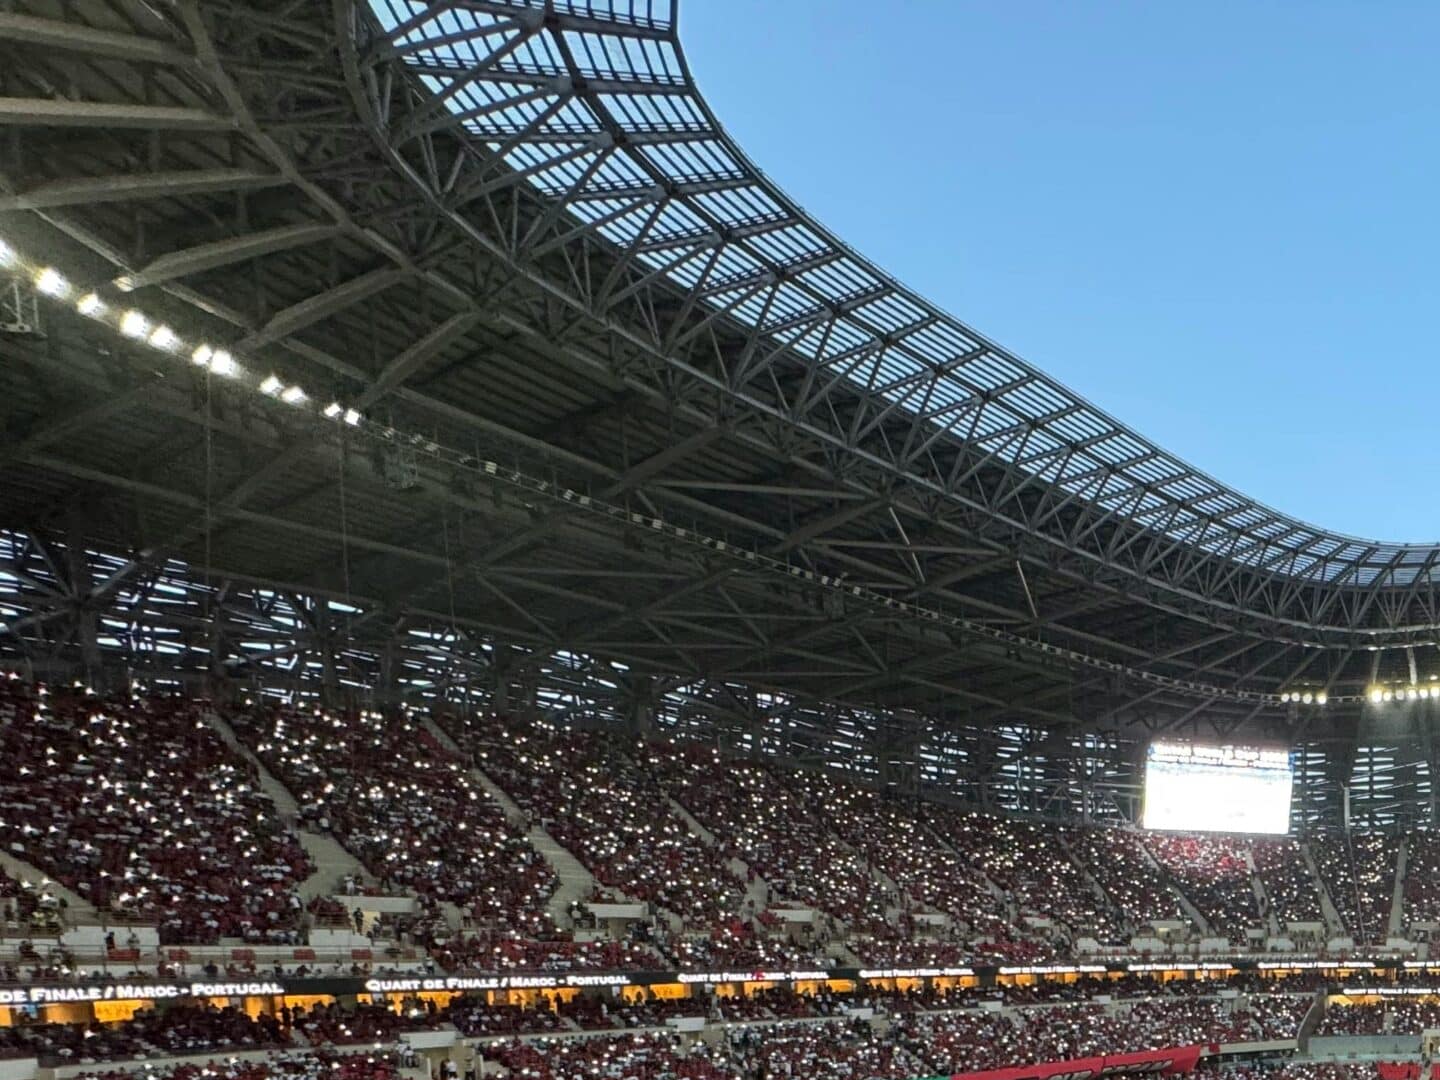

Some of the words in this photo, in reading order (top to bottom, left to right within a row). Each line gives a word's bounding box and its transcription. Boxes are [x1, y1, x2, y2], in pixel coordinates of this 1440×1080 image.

[366, 979, 421, 991] QUART
[423, 979, 444, 989] DE
[446, 978, 499, 988] FINALE
[510, 977, 556, 987] MAROC
[567, 976, 630, 985] PORTUGAL
[0, 988, 27, 1003] DE
[30, 986, 102, 1002] FINALE
[116, 985, 178, 999] MAROC
[191, 983, 285, 996] PORTUGAL
